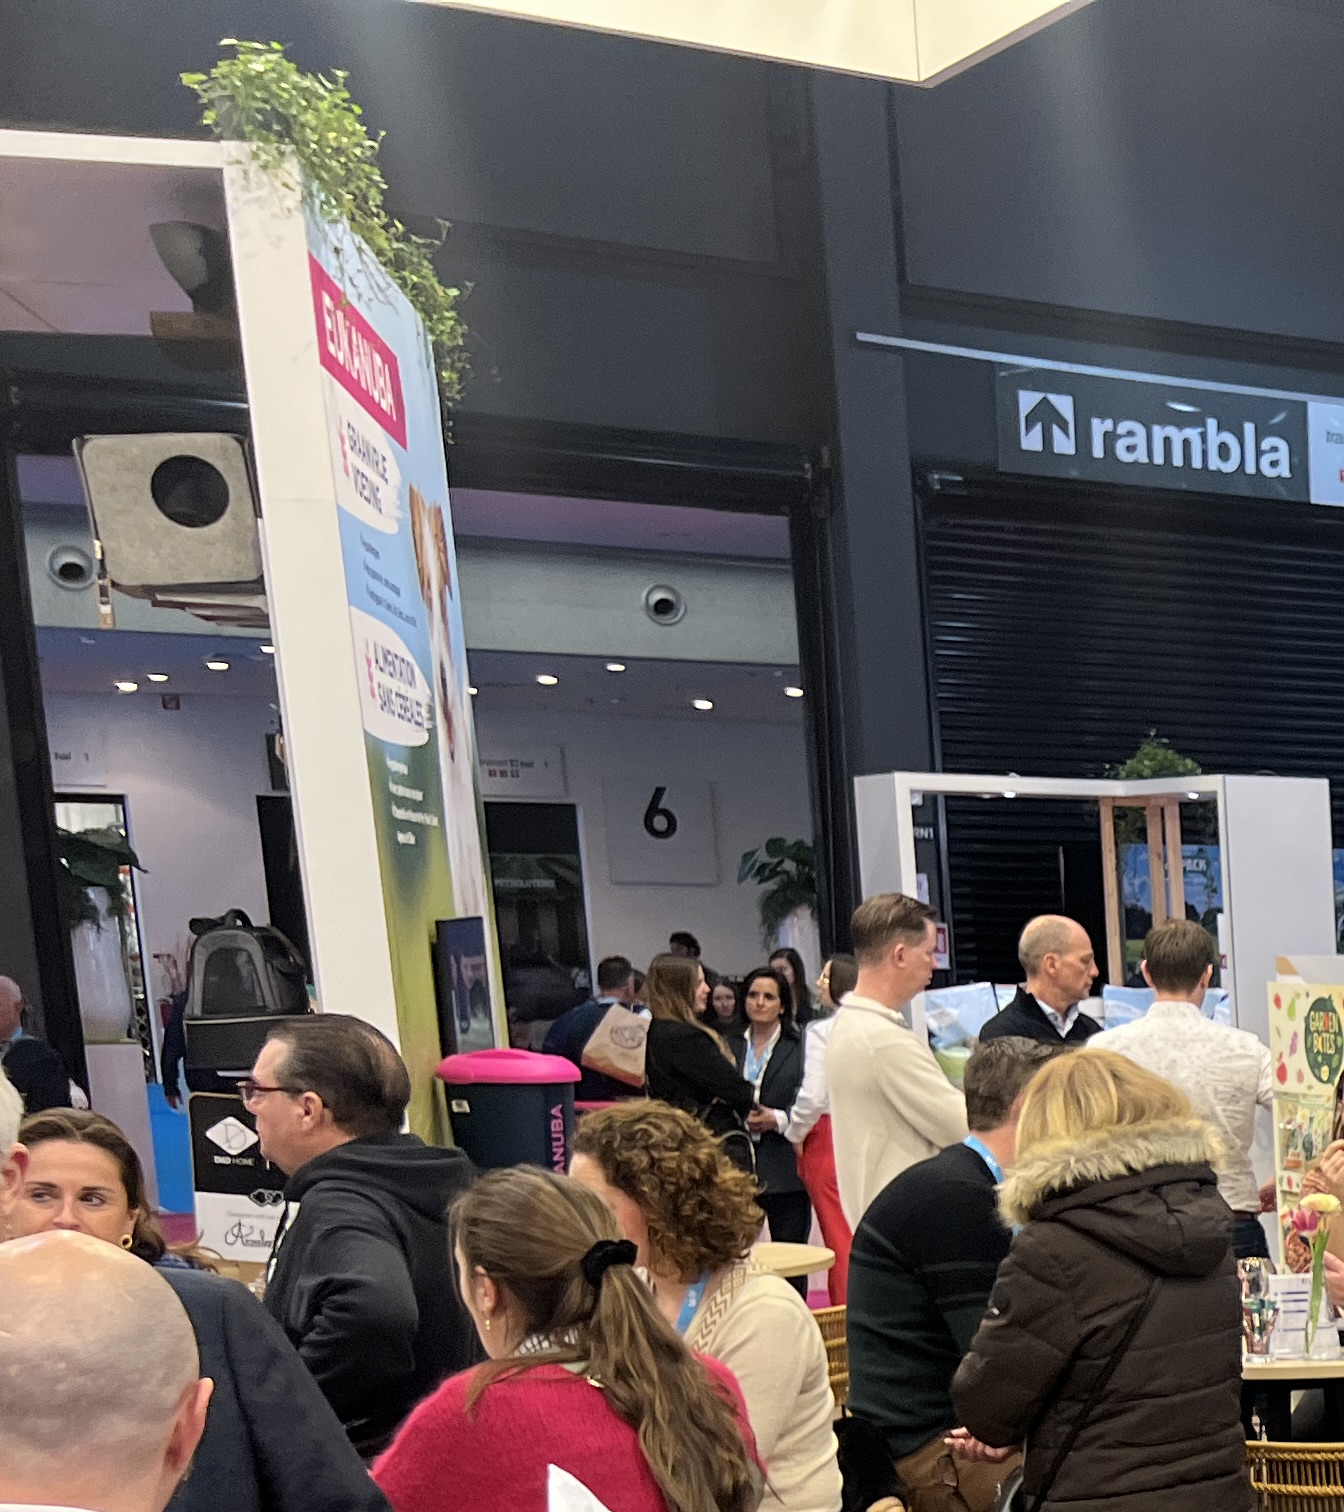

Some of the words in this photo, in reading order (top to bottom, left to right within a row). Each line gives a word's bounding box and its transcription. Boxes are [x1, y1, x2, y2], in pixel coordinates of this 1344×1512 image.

[321, 290, 397, 422] EUKANUBA
[1090, 415, 1293, 479] rambla
[643, 786, 678, 840] 6
[550, 1103, 566, 1175] ANUBA
